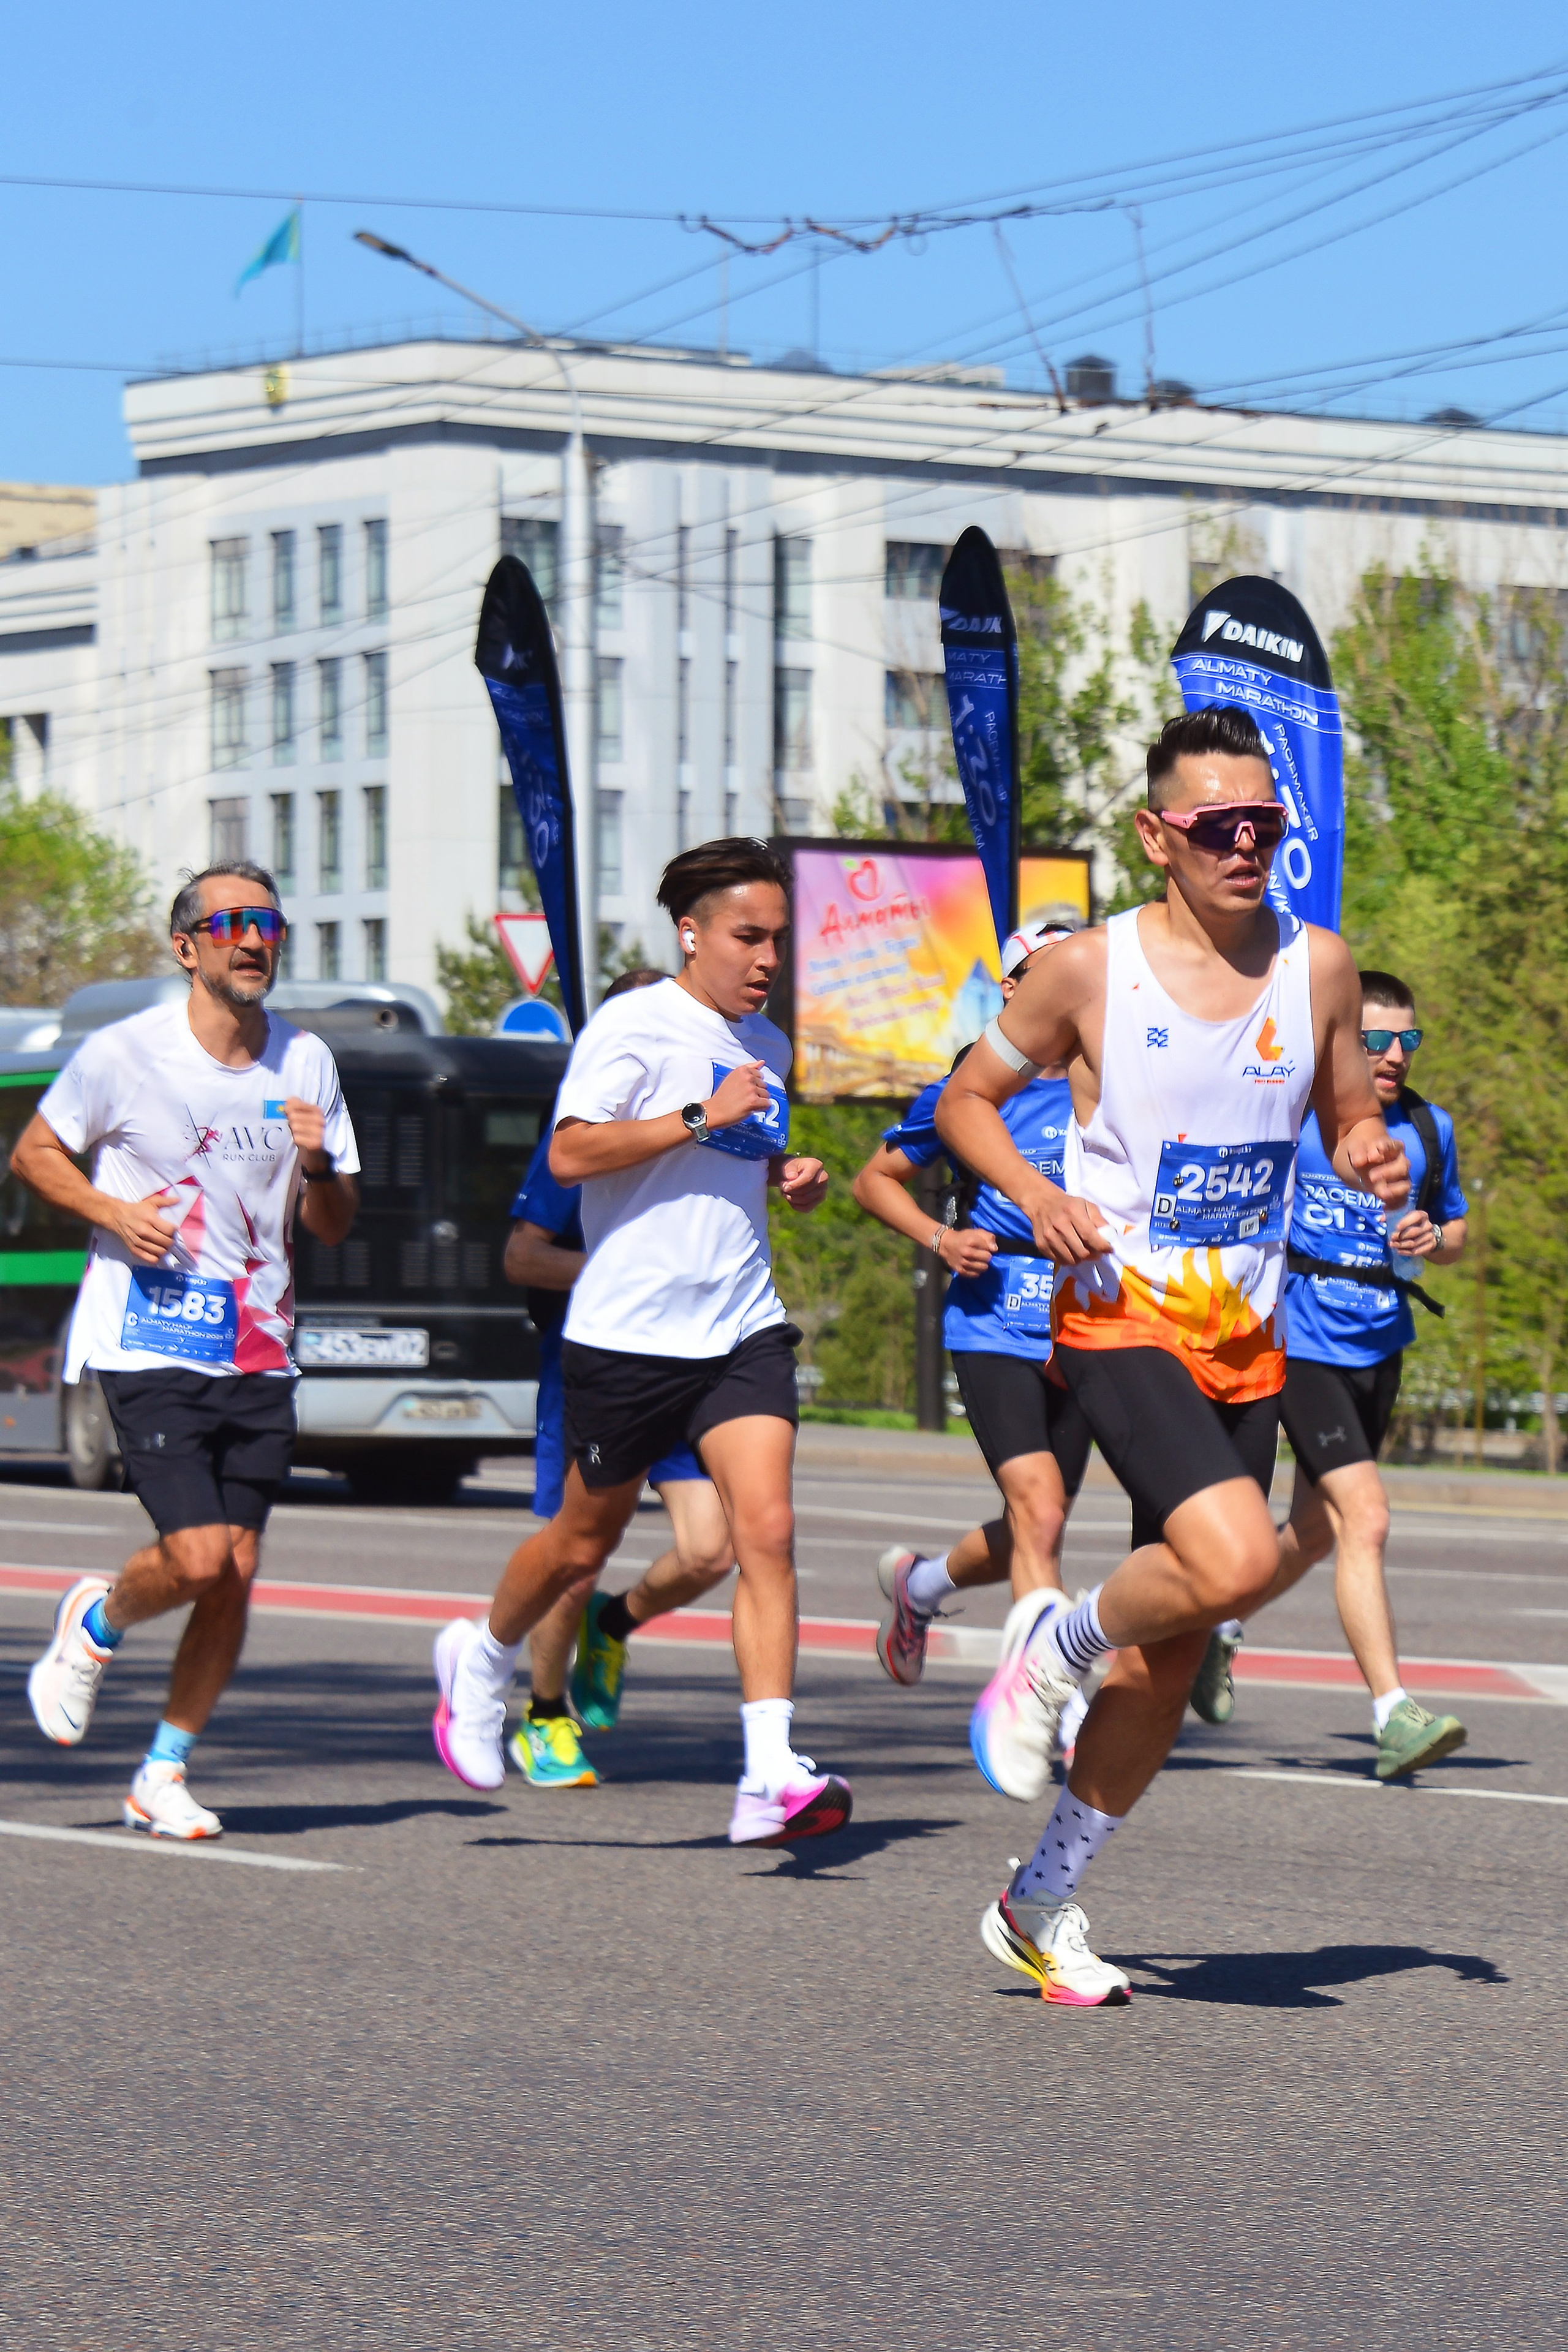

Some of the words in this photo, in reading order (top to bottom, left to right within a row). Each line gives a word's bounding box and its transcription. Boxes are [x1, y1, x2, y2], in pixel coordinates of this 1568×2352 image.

[948, 617, 1001, 633] DAIK
[1222, 619, 1304, 663] DAIKIN
[947, 652, 991, 663] MATY
[950, 671, 1006, 684] MARATH
[1192, 658, 1272, 685] ALMATY
[1216, 681, 1318, 726] MARATHON
[1274, 723, 1319, 842] PACEMAKER
[225, 1126, 282, 1150] AVC
[1177, 1158, 1274, 1202] 2542
[1158, 1197, 1171, 1214] D
[1175, 1205, 1211, 1215] ALMATY
[1021, 1273, 1054, 1300] 35
[149, 1286, 227, 1325] 1583
[1009, 1296, 1019, 1308] D
[127, 1312, 138, 1327] C
[141, 1317, 170, 1327] ALMATY
[163, 1326, 205, 1338] MARATHON
